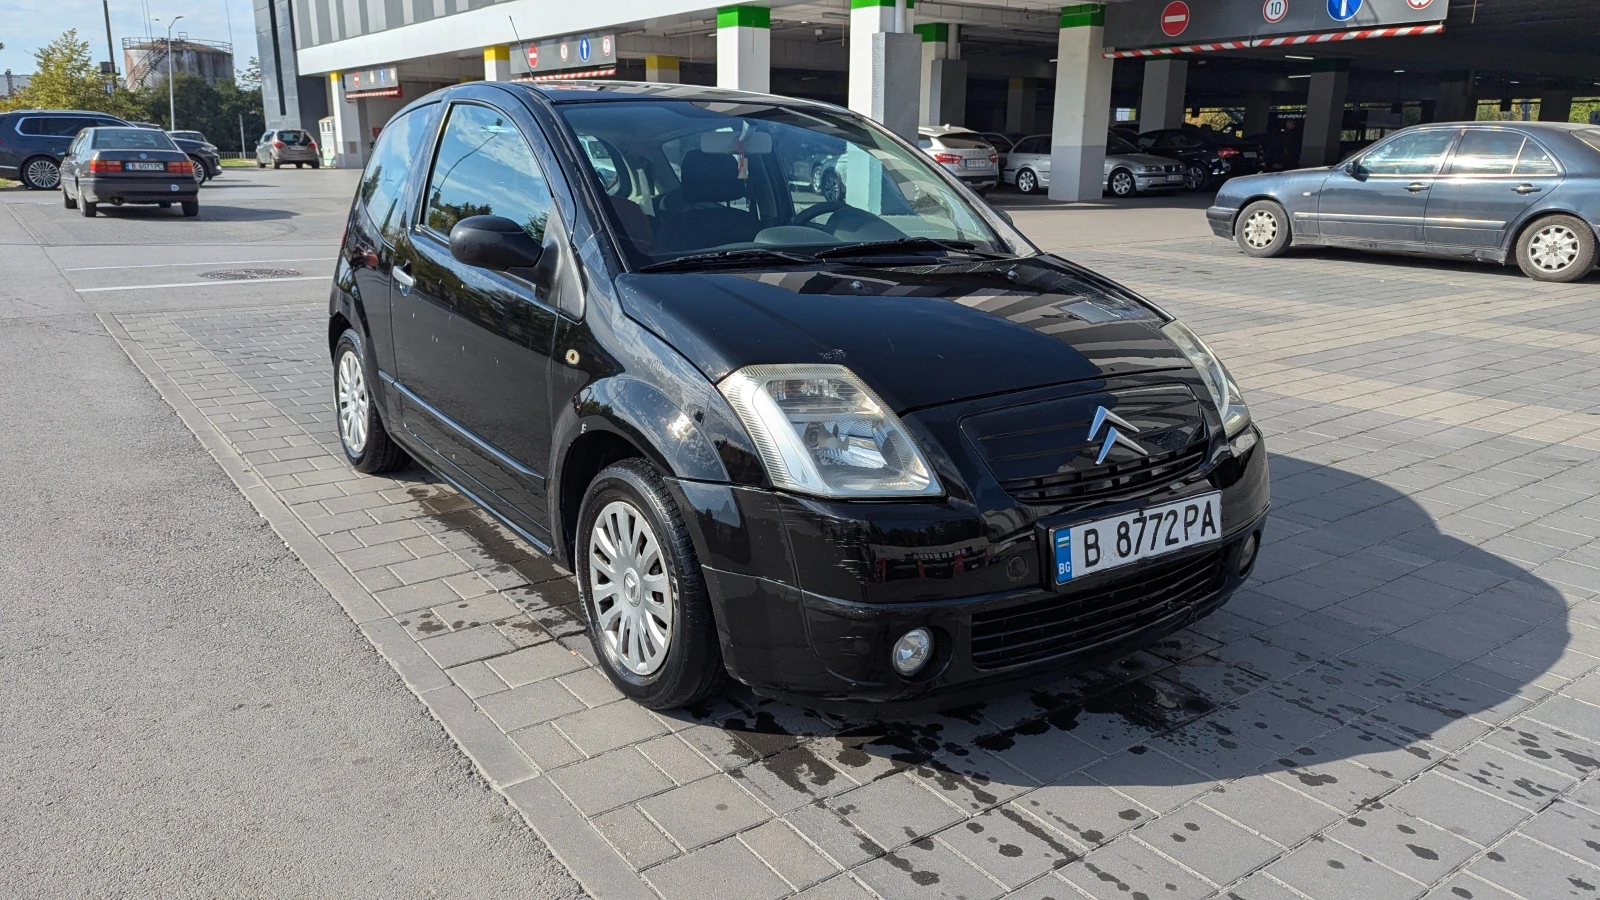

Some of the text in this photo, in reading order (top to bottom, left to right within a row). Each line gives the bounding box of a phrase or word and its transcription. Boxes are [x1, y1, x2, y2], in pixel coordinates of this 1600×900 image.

[1270, 1, 1281, 15] 10
[1084, 500, 1217, 568] B 8772PA
[1058, 561, 1071, 575] BG
